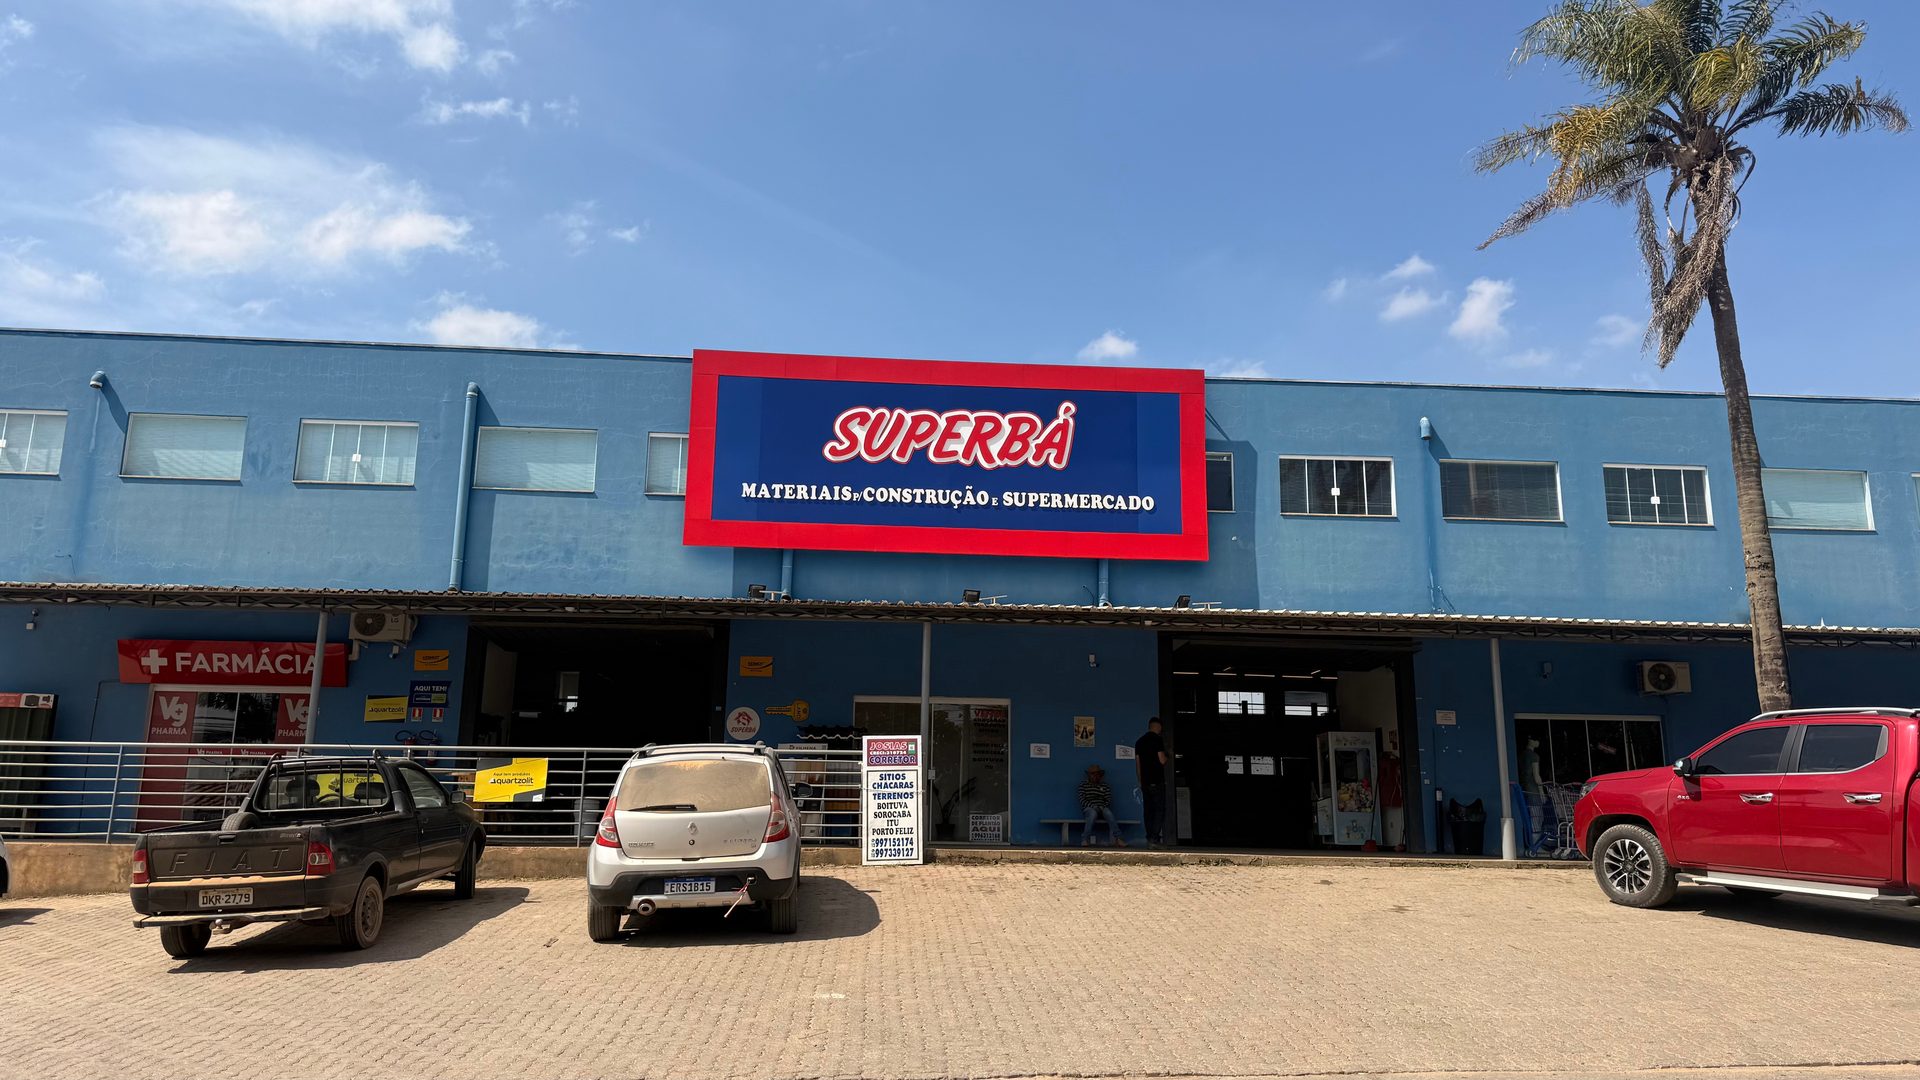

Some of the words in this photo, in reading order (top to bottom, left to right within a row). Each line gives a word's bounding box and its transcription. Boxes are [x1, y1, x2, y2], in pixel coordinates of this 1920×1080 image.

[742, 482, 852, 501] MATERIAIS
[863, 485, 990, 509] CONSTRUÇÃO
[991, 497, 999, 506] E
[1002, 491, 1156, 512] SUPERMERCADO
[175, 647, 317, 674] FARMÁCIA
[151, 727, 187, 735] PHARMA
[278, 729, 307, 737] PHARM
[869, 741, 908, 751] JOSIAS
[869, 755, 917, 765] CORRETOR
[496, 776, 534, 786] quartzolit
[872, 781, 914, 790] CHACARAS
[872, 791, 914, 801] TERRENOS
[877, 801, 908, 810] BOITUVA
[873, 810, 912, 819] SOROCABA
[886, 819, 899, 827] ITU
[872, 827, 894, 836] PORTO
[895, 827, 914, 835] FELIZ
[875, 837, 914, 847] 997152174
[875, 847, 914, 858] 997339127
[170, 849, 289, 873] FIAT
[670, 882, 711, 893] ERS1B15
